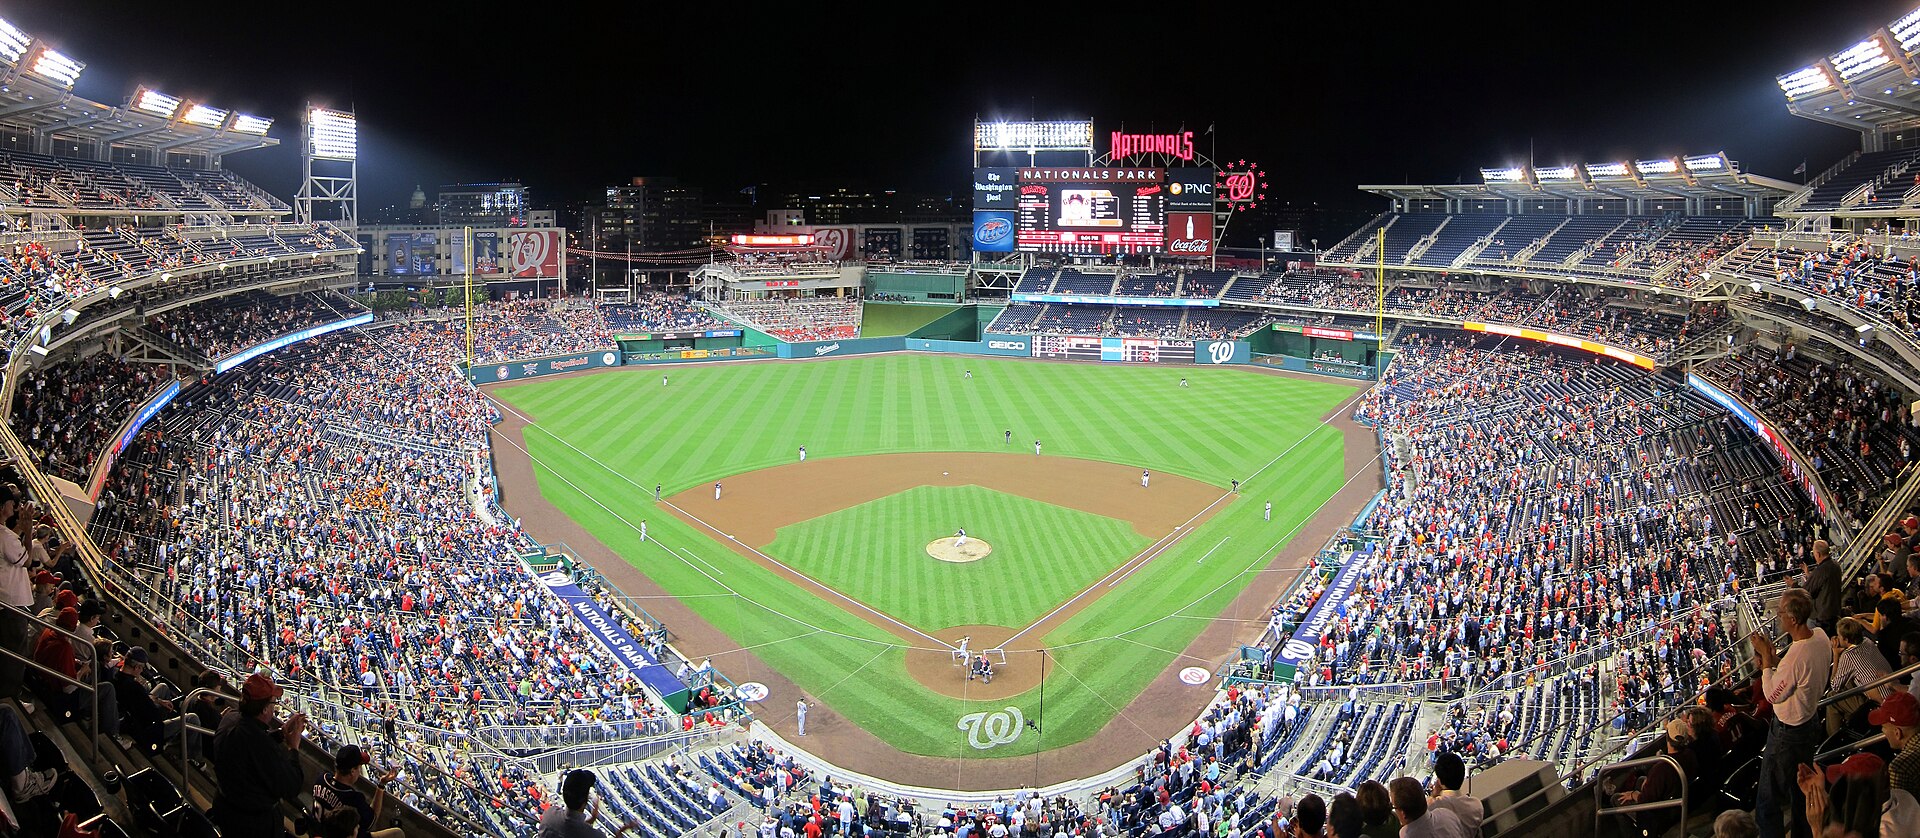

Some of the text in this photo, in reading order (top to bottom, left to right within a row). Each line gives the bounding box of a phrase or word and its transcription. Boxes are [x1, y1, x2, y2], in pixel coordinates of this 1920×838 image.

[1111, 131, 1194, 161] NATIONALS
[987, 173, 1000, 181] The
[1023, 170, 1156, 179] NATIONALS PARK
[975, 182, 1013, 192] Washington
[1185, 184, 1211, 194] PNC
[986, 193, 1001, 203] Post
[1136, 245, 1142, 253] 0
[1155, 245, 1161, 253] 2
[988, 340, 1025, 350] GEICO
[551, 357, 588, 371] ExxonMobil
[1302, 553, 1369, 637] WASHINGTON NATIONALS
[574, 601, 652, 670] NATIONALS PARK
